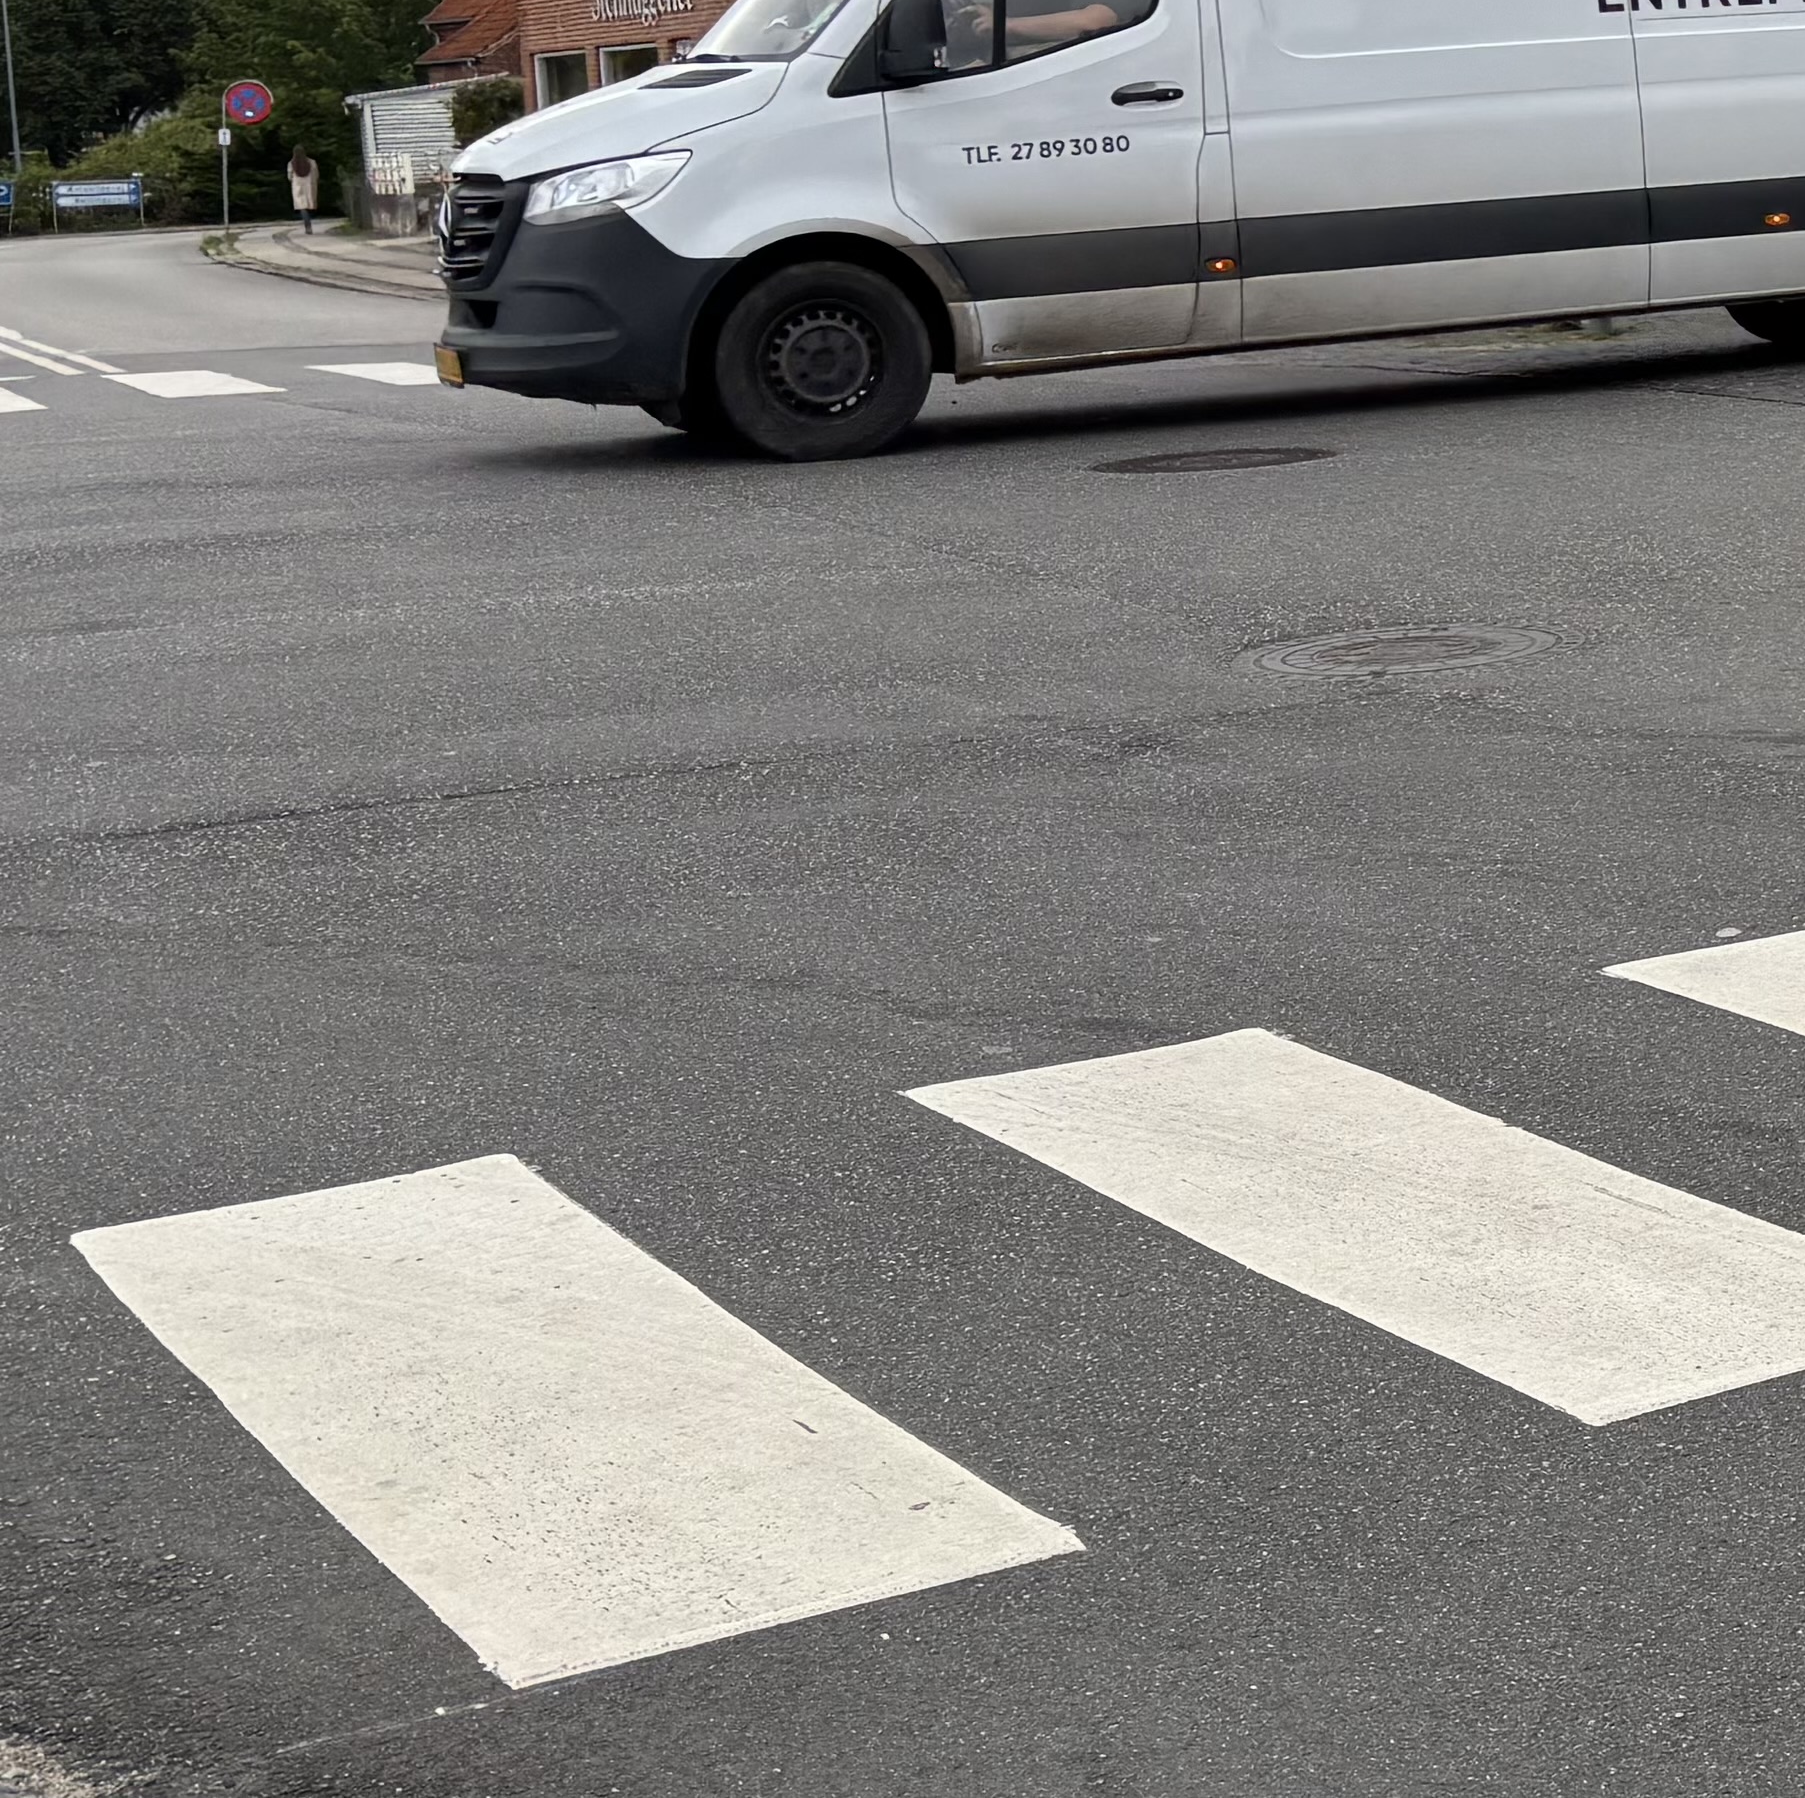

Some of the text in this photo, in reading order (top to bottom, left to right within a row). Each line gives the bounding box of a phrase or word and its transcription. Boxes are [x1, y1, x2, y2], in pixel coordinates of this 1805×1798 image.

[962, 135, 1130, 165] TLF. 27 89 30 80
